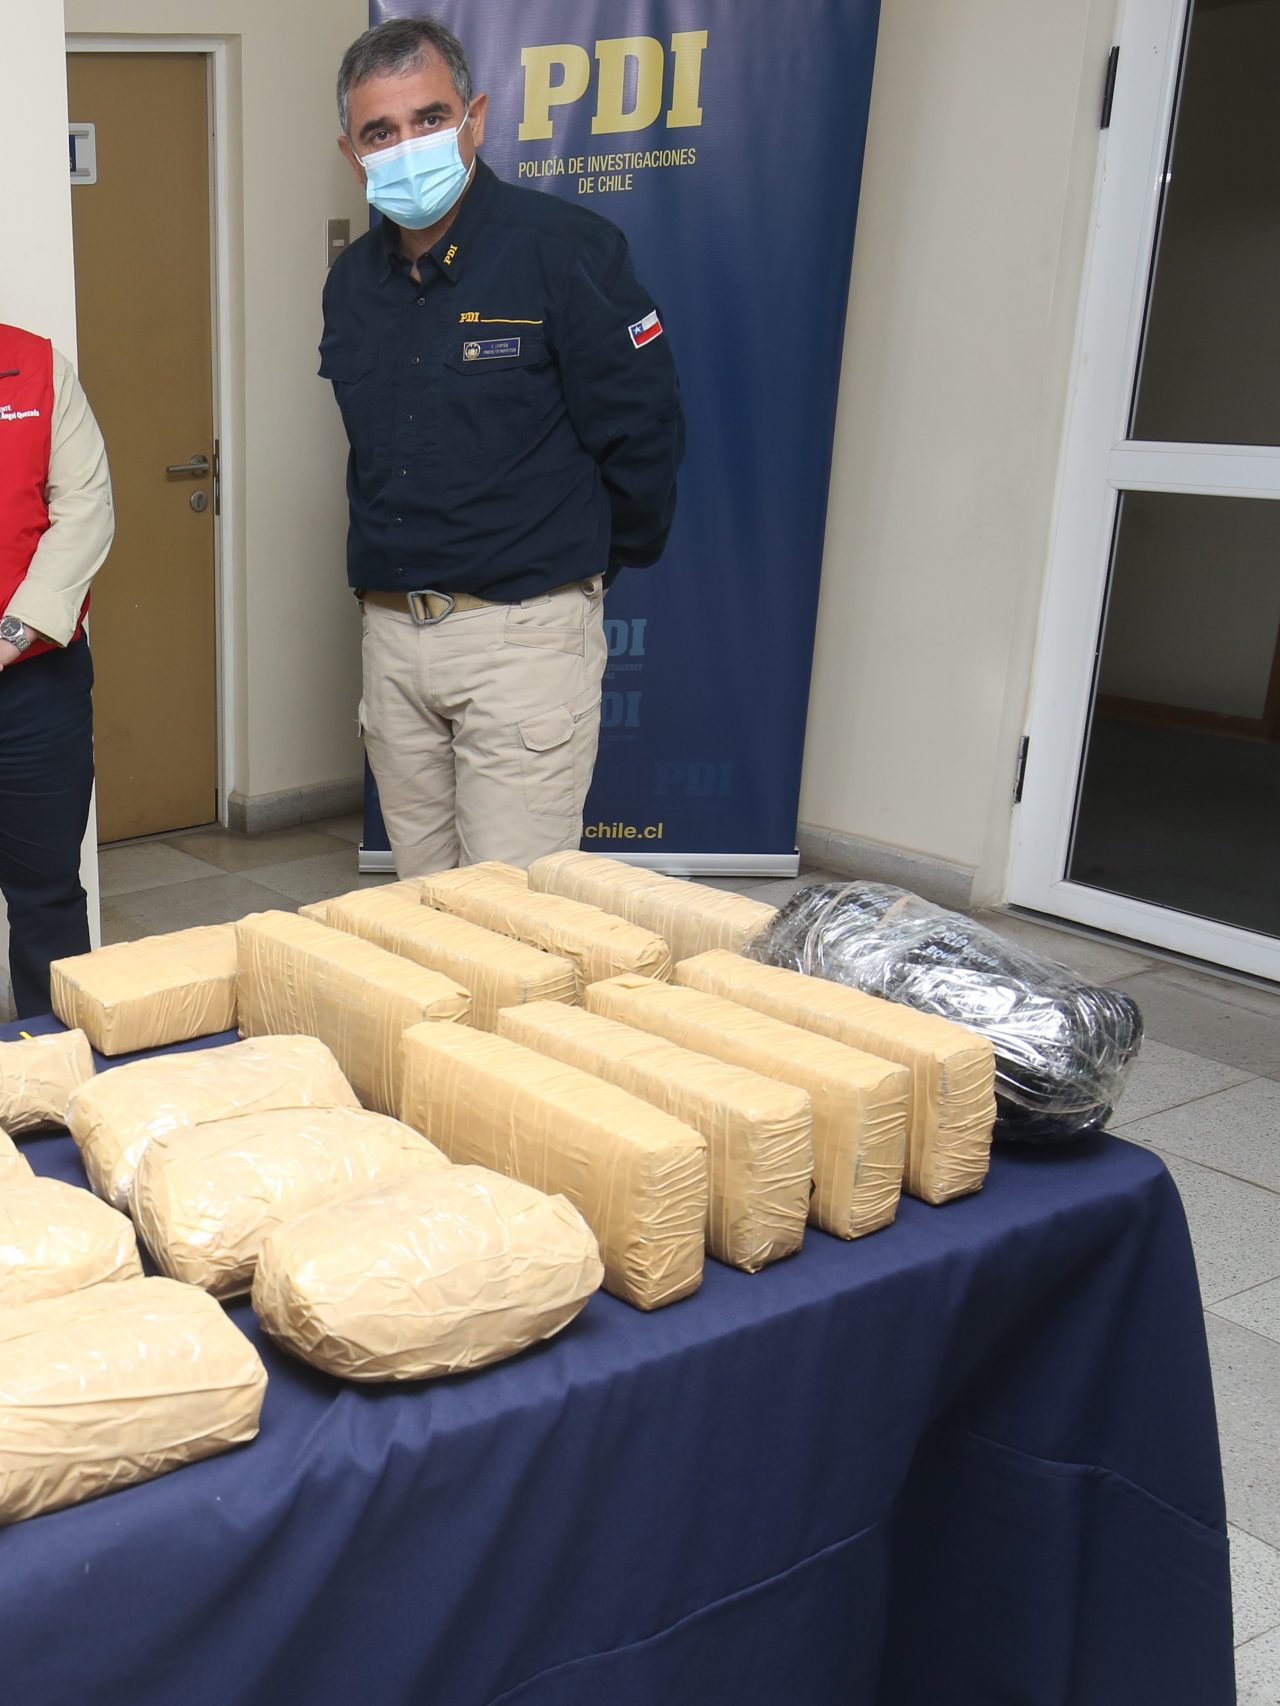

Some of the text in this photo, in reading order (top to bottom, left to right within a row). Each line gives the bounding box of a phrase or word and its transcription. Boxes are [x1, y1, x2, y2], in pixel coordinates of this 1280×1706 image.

[518, 30, 708, 141] PDI
[518, 148, 696, 178] POLICÍA DE INVESTIGACIONES
[578, 174, 633, 194] DE CHILE
[443, 244, 458, 265] PDI
[459, 312, 480, 323] PDI
[604, 618, 647, 656] DI
[601, 690, 643, 728] DI
[583, 822, 664, 839] chile.cl
